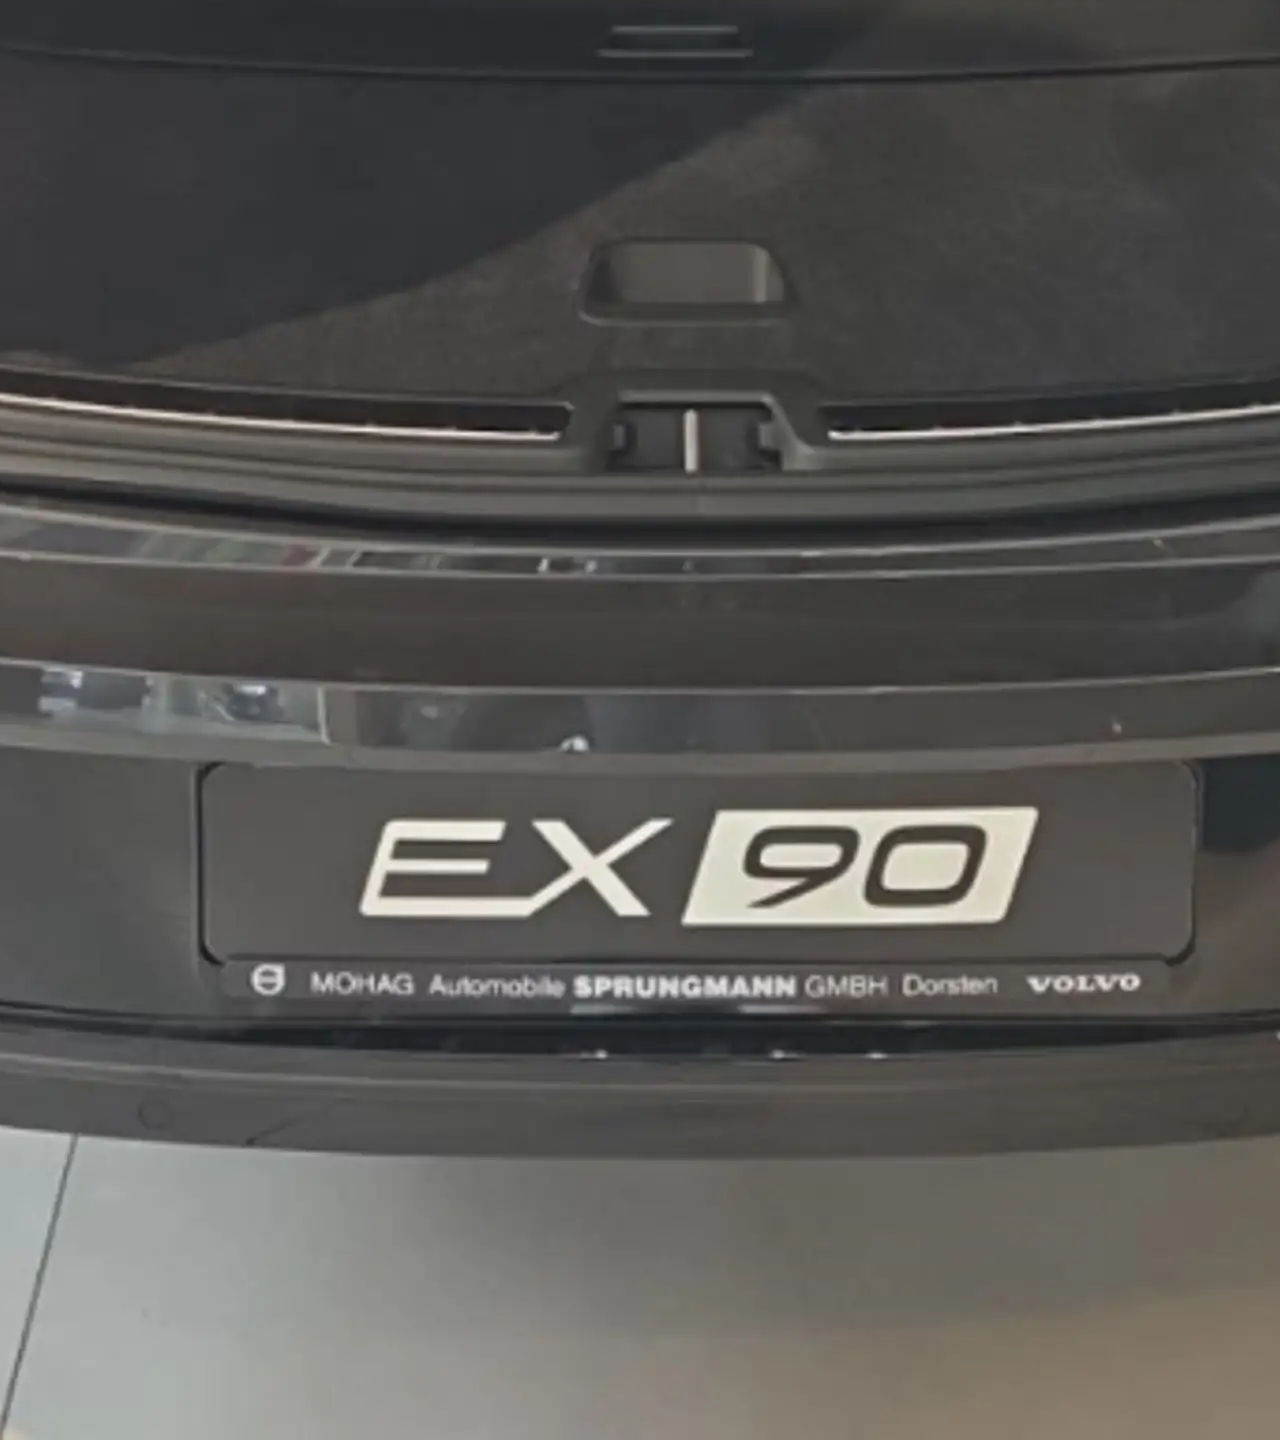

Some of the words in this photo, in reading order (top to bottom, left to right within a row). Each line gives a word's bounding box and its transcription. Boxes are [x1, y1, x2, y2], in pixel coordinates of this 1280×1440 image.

[359, 819, 673, 917] EX
[743, 824, 987, 908] 90
[310, 971, 414, 996] MOHAG
[429, 973, 567, 998] Automobile
[573, 974, 796, 1000] SPRUNGMANN
[804, 974, 889, 998] GMBH
[901, 972, 999, 996] Dorsten
[1025, 973, 1141, 992] VOLVO
